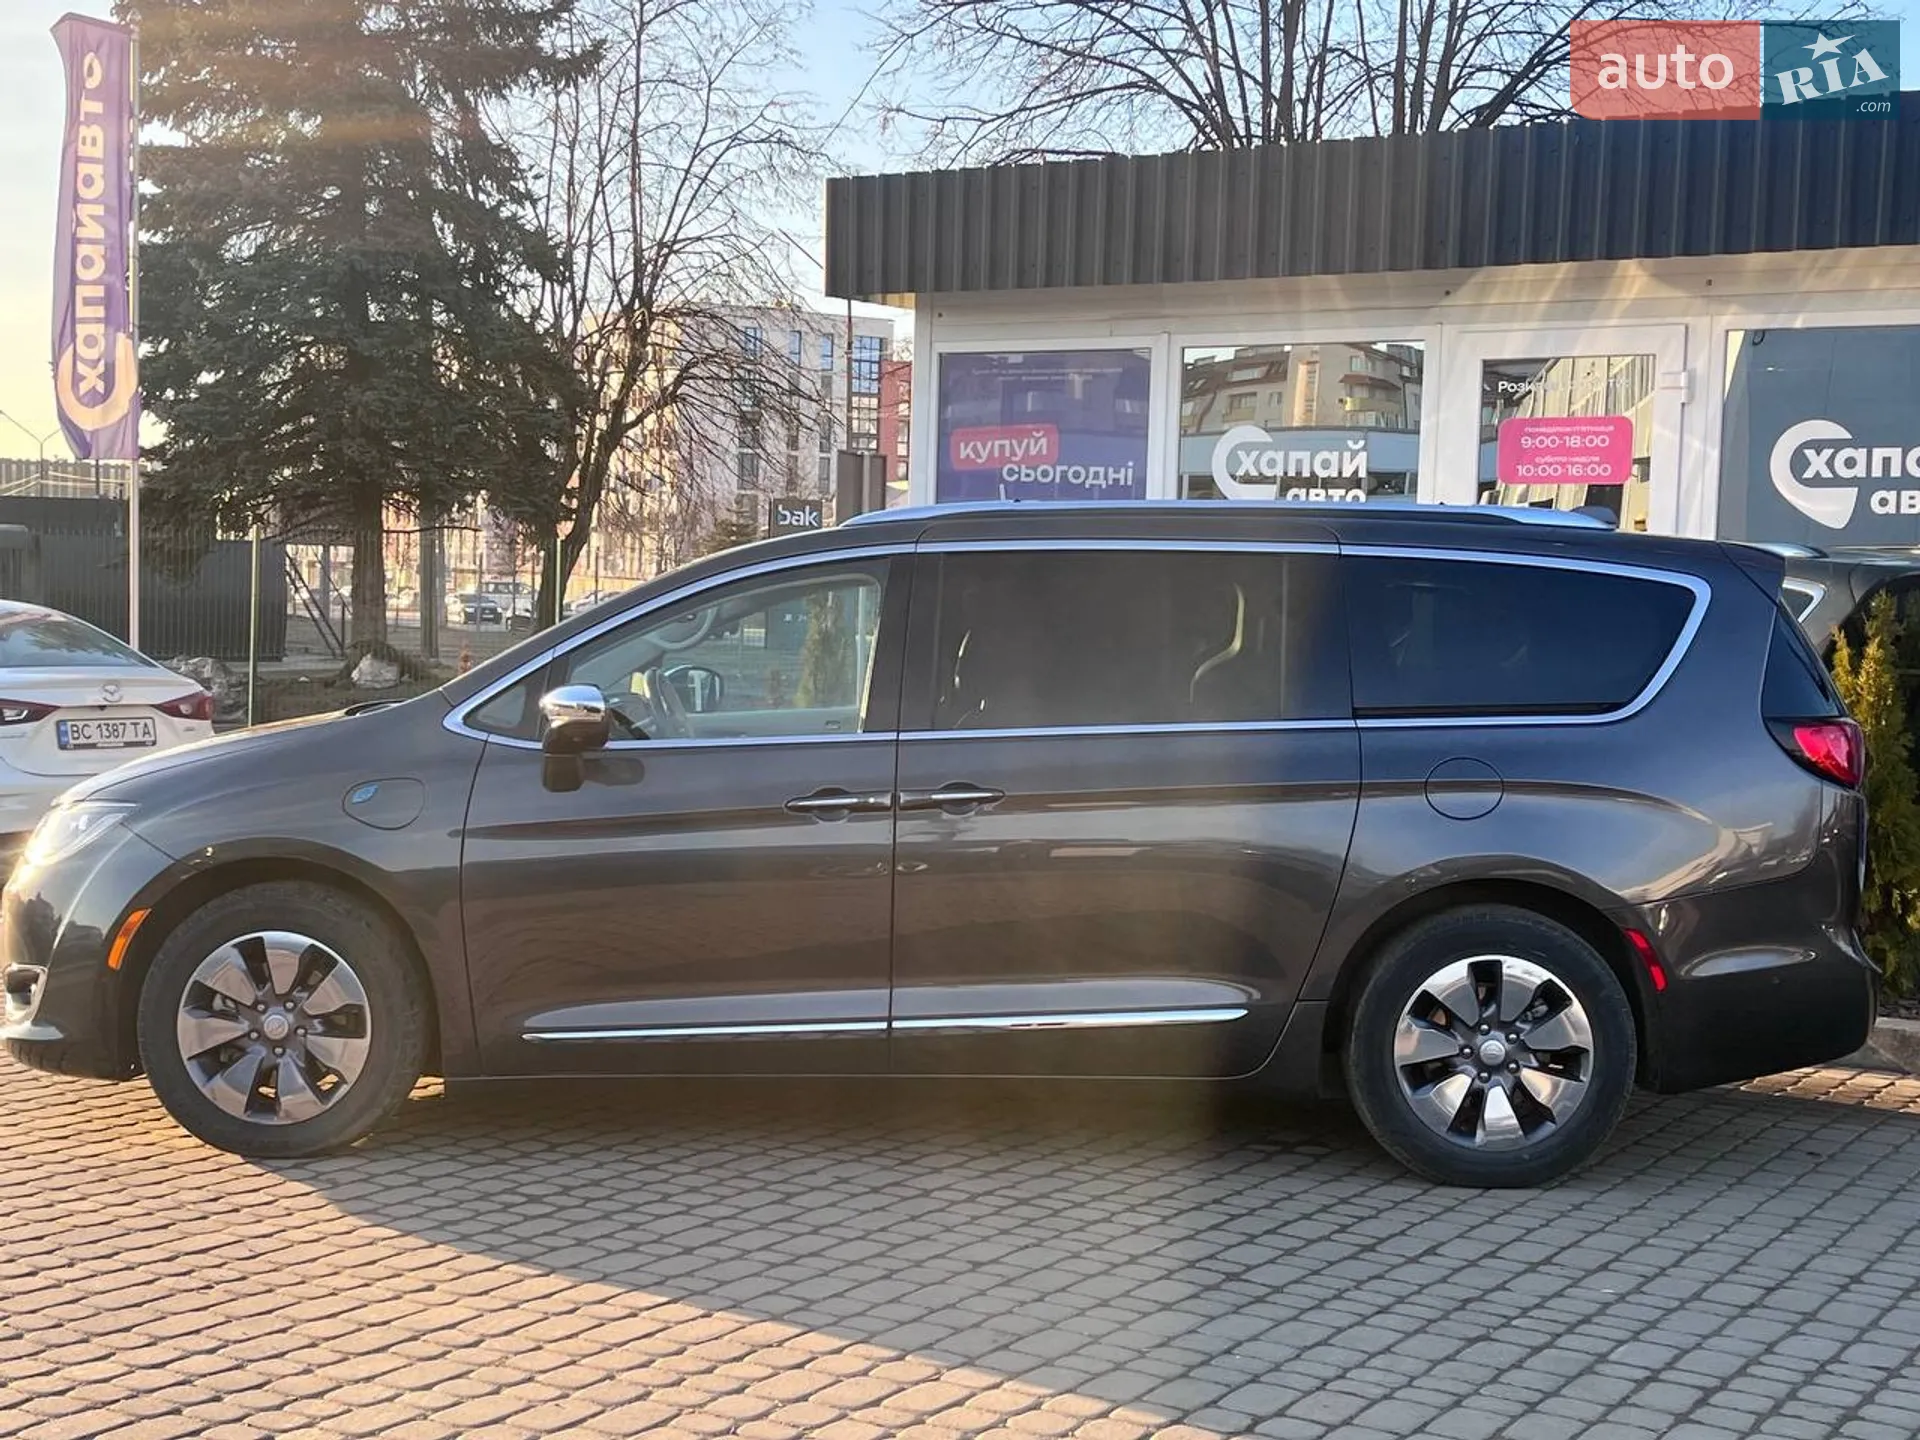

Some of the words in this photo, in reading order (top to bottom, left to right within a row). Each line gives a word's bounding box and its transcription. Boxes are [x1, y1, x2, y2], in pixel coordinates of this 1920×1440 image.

[959, 430, 1048, 463] купуй
[1520, 435, 1610, 449] 9:00-18:00
[1236, 439, 1368, 479] хапай
[1002, 461, 1134, 489] сьогодні
[70, 723, 92, 740] BC
[96, 722, 127, 739] 1387
[130, 721, 152, 739] TA
